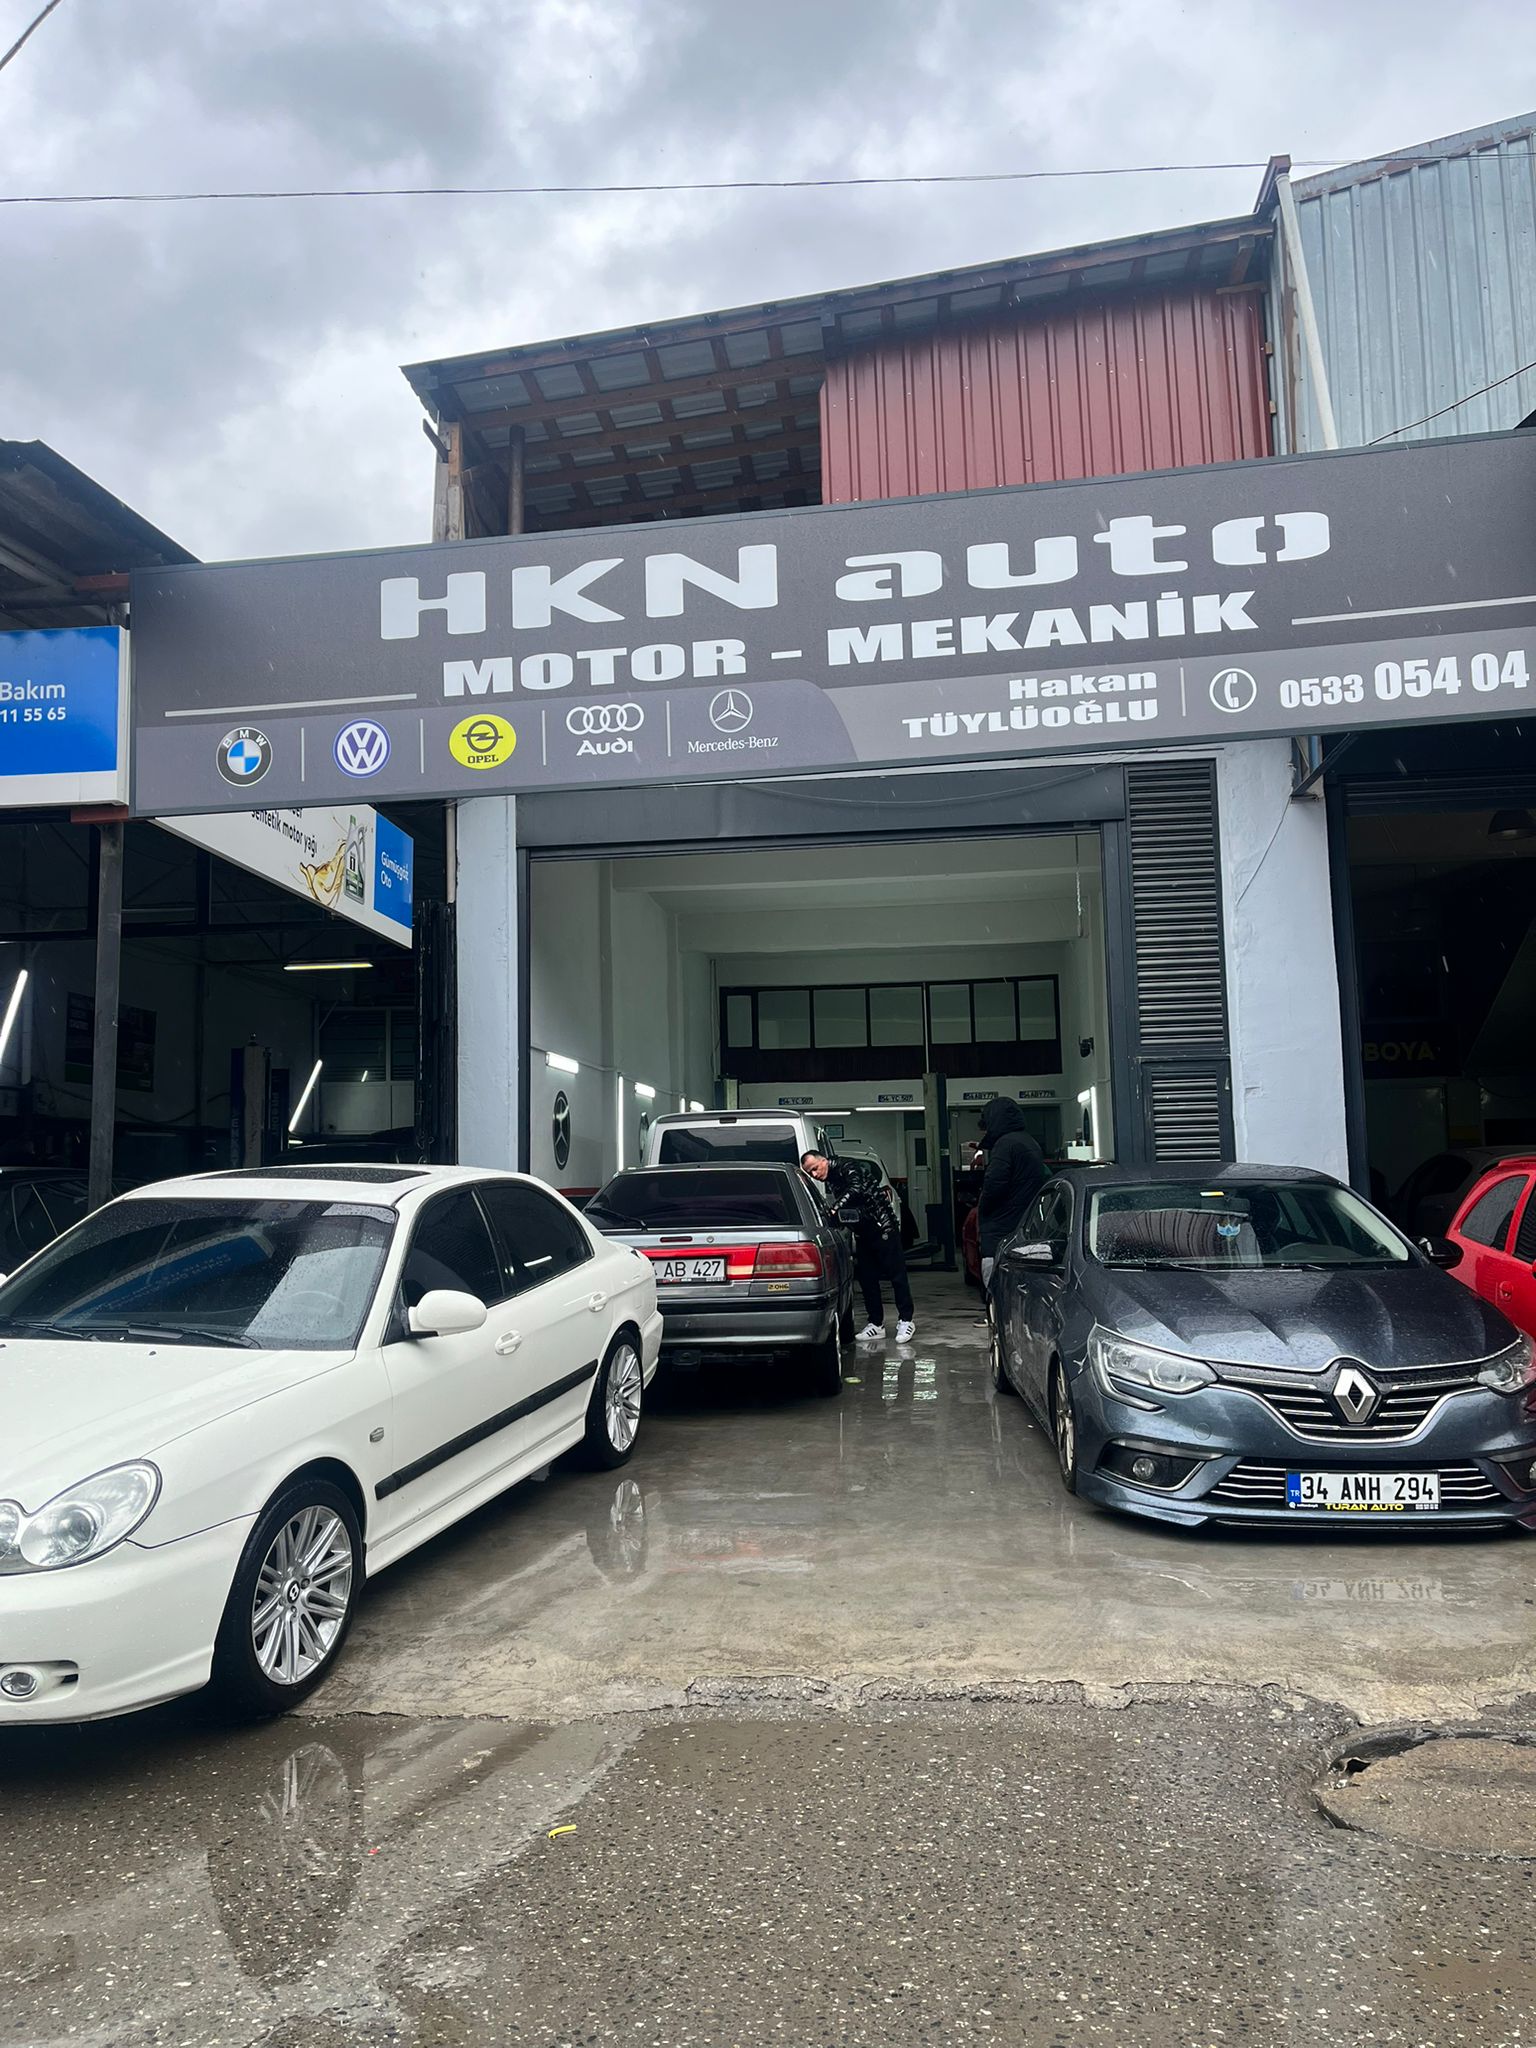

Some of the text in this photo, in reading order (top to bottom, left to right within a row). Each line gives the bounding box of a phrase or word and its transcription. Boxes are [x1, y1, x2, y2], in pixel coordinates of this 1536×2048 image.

[380, 511, 1331, 640] HKN auto
[442, 638, 747, 697] MOTOR
[827, 590, 1259, 666] MEKANİK
[0, 679, 66, 701] Bakım
[1008, 670, 1158, 701] Hakan
[1280, 649, 1530, 709] 0533 054 04
[24, 708, 43, 722] 55
[47, 706, 66, 721] 65
[902, 698, 1159, 739] TÜYLÜOĞLU
[222, 729, 268, 749] BMW
[687, 735, 779, 754] Mercedes-Benz
[467, 754, 499, 764] OPEL
[282, 821, 303, 845] motor
[381, 870, 392, 889] Oto
[1363, 1040, 1436, 1062] BOYA
[663, 1261, 686, 1277] AB
[692, 1260, 721, 1277] 427
[1290, 1489, 1300, 1497] TR
[1302, 1476, 1434, 1501] 34 ANH 294
[1325, 1502, 1368, 1511] TURAN
[1370, 1502, 1405, 1511] AUTO
